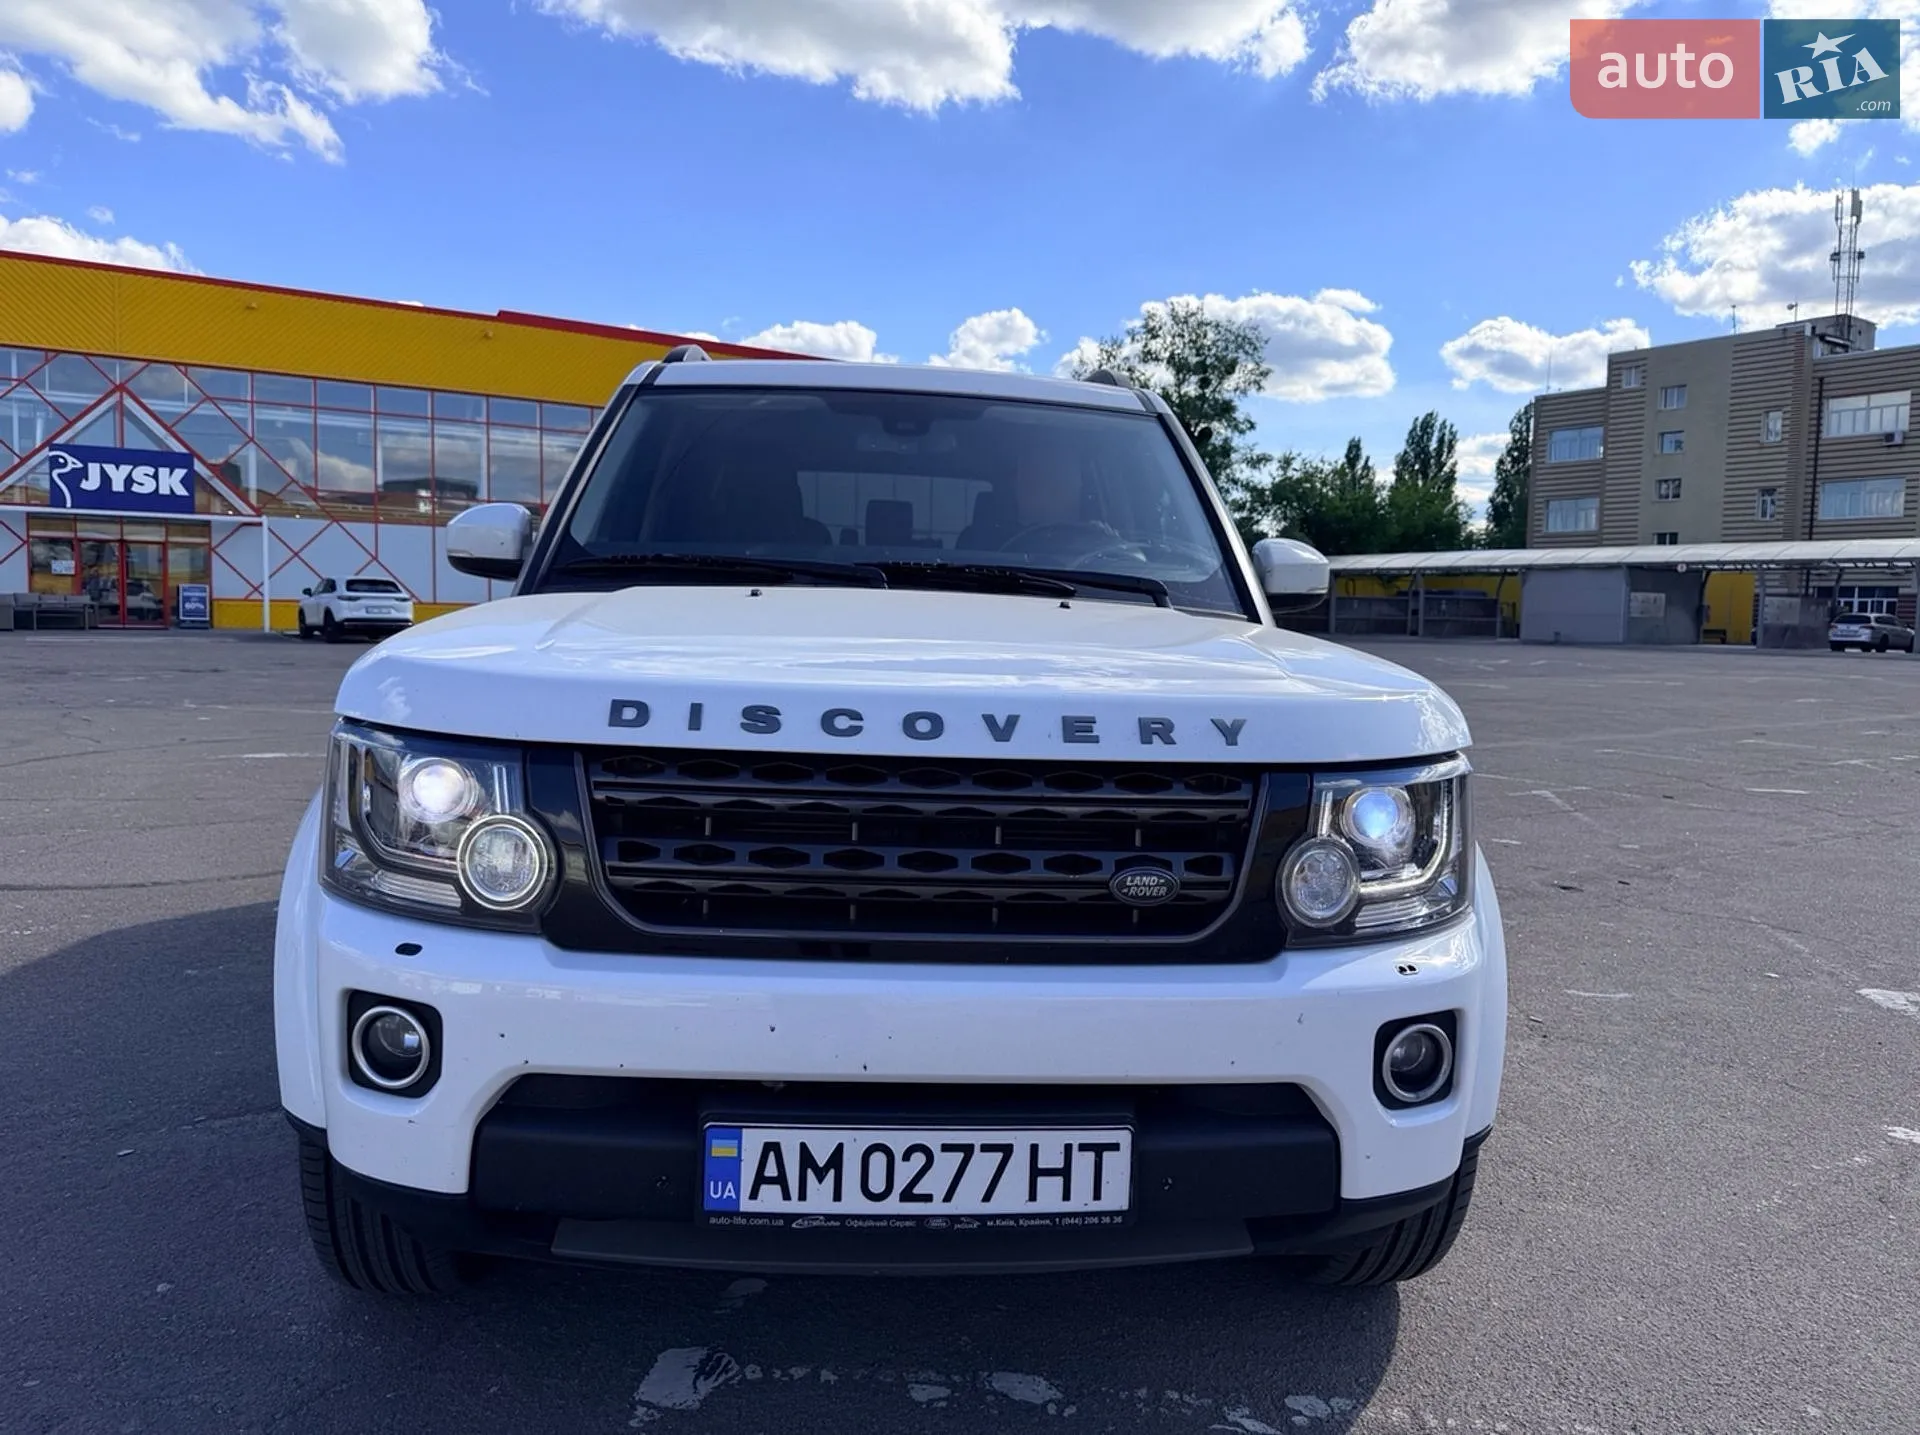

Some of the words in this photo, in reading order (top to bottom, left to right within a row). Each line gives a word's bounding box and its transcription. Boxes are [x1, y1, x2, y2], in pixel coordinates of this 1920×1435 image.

[80, 462, 189, 496] JYSK
[606, 698, 1248, 747] DISCOVERY
[709, 1180, 736, 1200] UA
[709, 1215, 784, 1227] auto-life.com.ua
